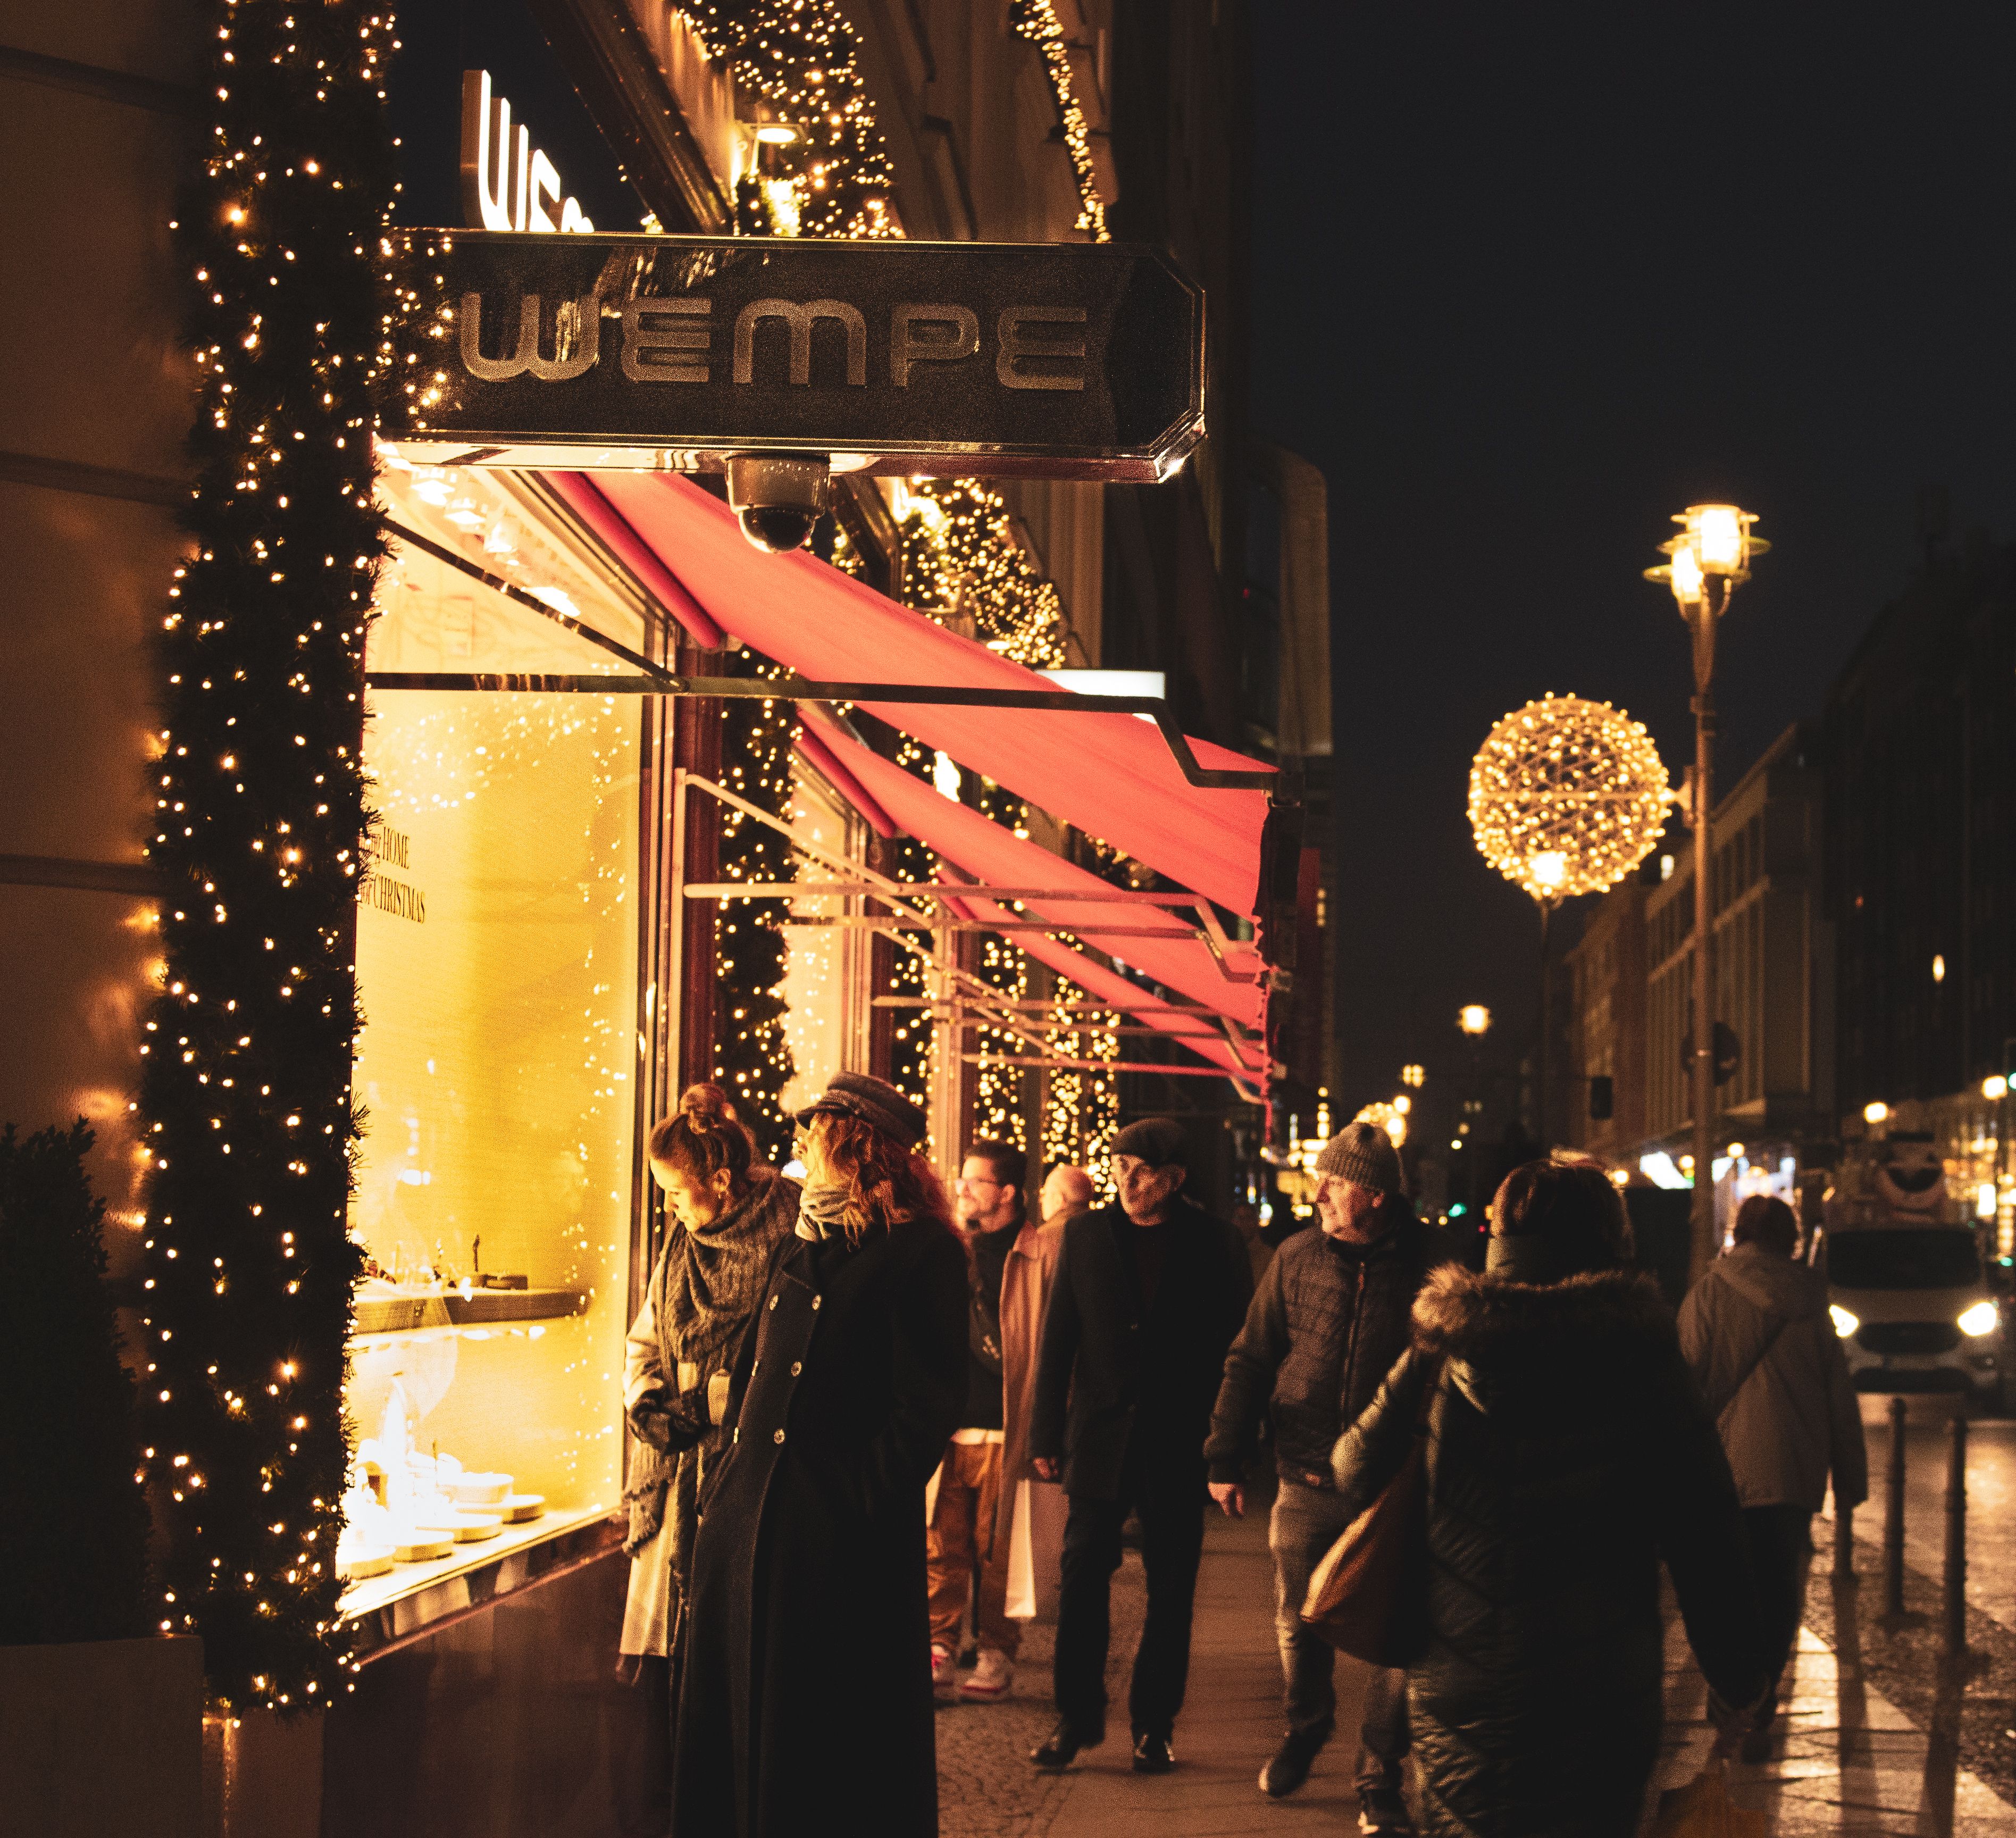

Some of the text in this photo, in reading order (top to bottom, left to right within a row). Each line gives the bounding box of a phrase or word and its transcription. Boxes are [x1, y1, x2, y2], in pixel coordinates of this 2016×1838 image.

[460, 292, 1087, 391] WEMPE
[382, 826, 409, 870] HOME
[373, 873, 425, 924] CHRISTMAS
